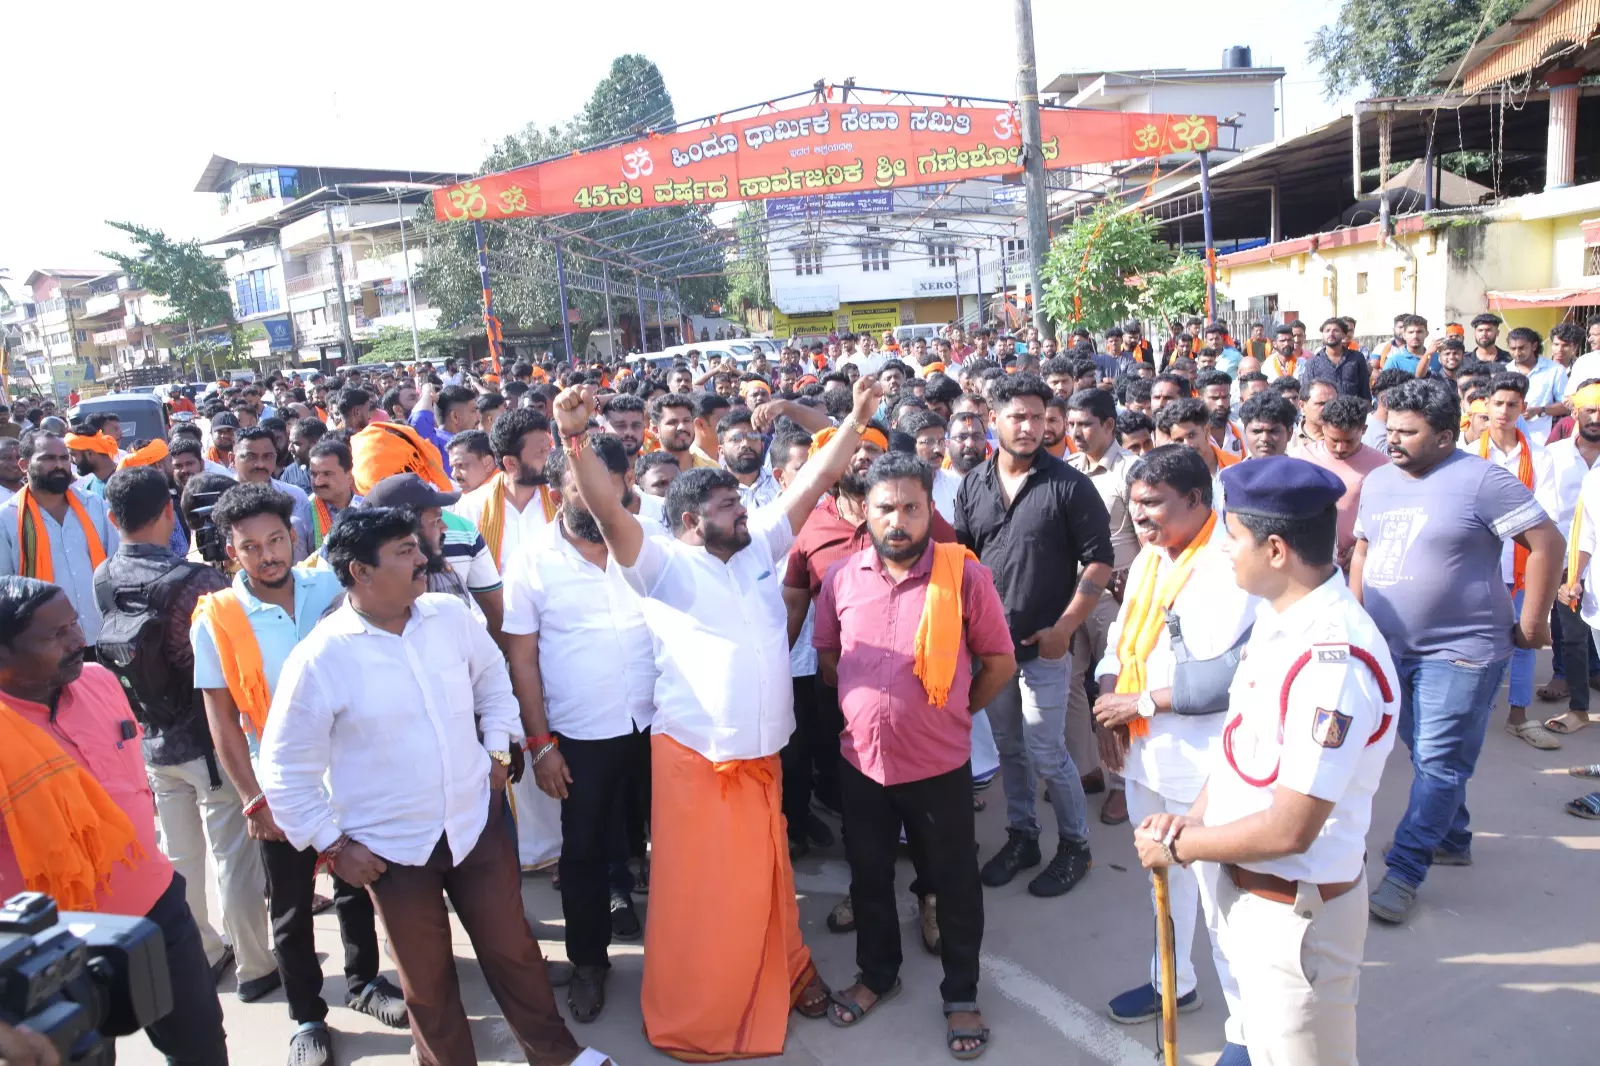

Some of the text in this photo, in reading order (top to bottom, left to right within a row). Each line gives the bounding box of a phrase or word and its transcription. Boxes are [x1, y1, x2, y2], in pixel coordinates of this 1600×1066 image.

[671, 107, 971, 168] ಹಿಂದೂ ಧಾರ್ಮಿಕ ಸೇವಾ ಸಮಿತಿ
[573, 136, 1059, 209] 45ನೇ ವರ್ಷದ ಸಾರ್ವಜನಿಕ ಶ್ರೀ ಗಣೇಶೋವ
[1008, 272, 1030, 281] LOGISTI
[920, 280, 961, 291] XEROX
[793, 324, 828, 334] UltraTech
[858, 320, 892, 331] UltraTech
